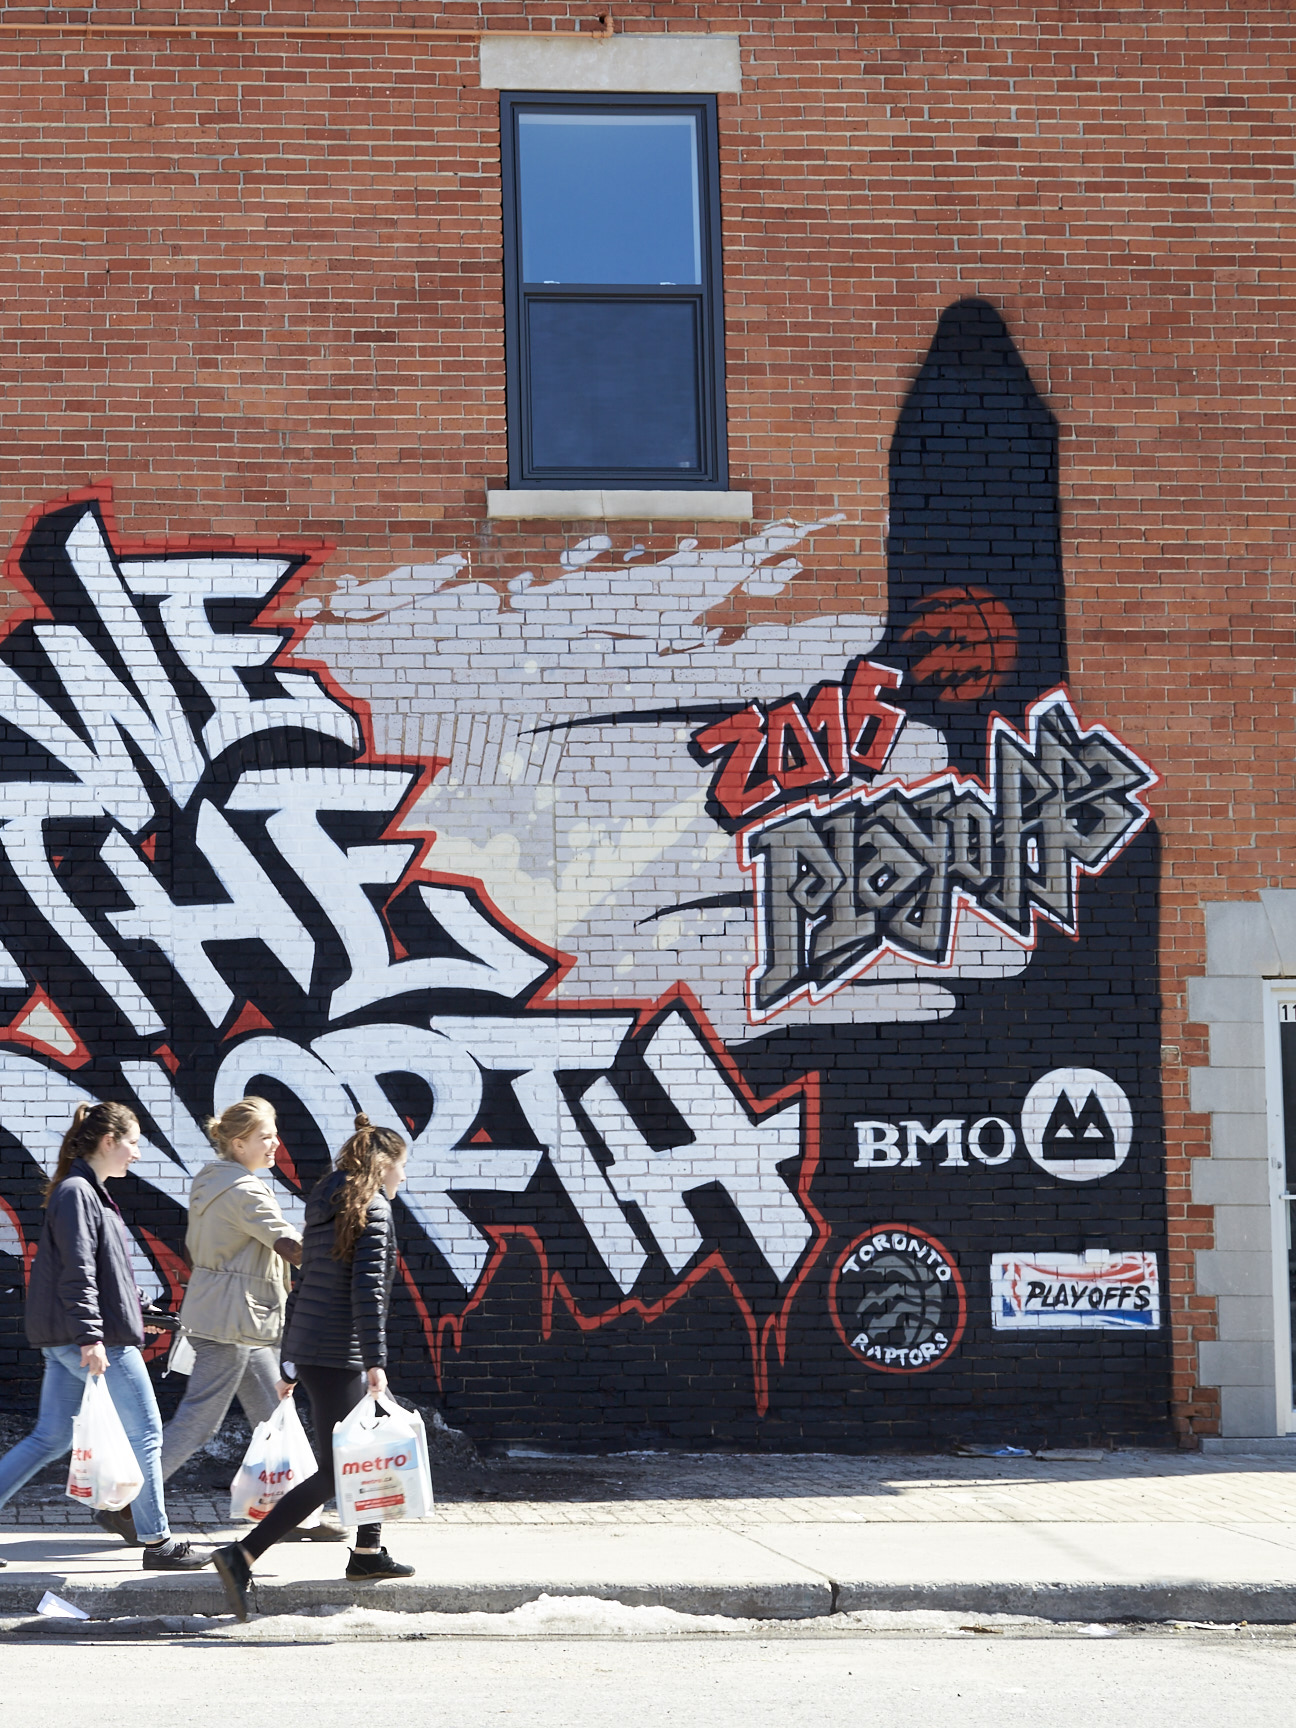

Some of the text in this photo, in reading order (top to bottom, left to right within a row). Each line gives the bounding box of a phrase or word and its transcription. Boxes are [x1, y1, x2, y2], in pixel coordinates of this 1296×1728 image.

[694, 659, 906, 820] 2016
[853, 1116, 1017, 1168] BMO
[841, 1233, 952, 1282] TORONTO
[1025, 1280, 1152, 1311] PLAYOFFS
[850, 1331, 949, 1367] RAPTORS
[342, 1454, 408, 1475] metro
